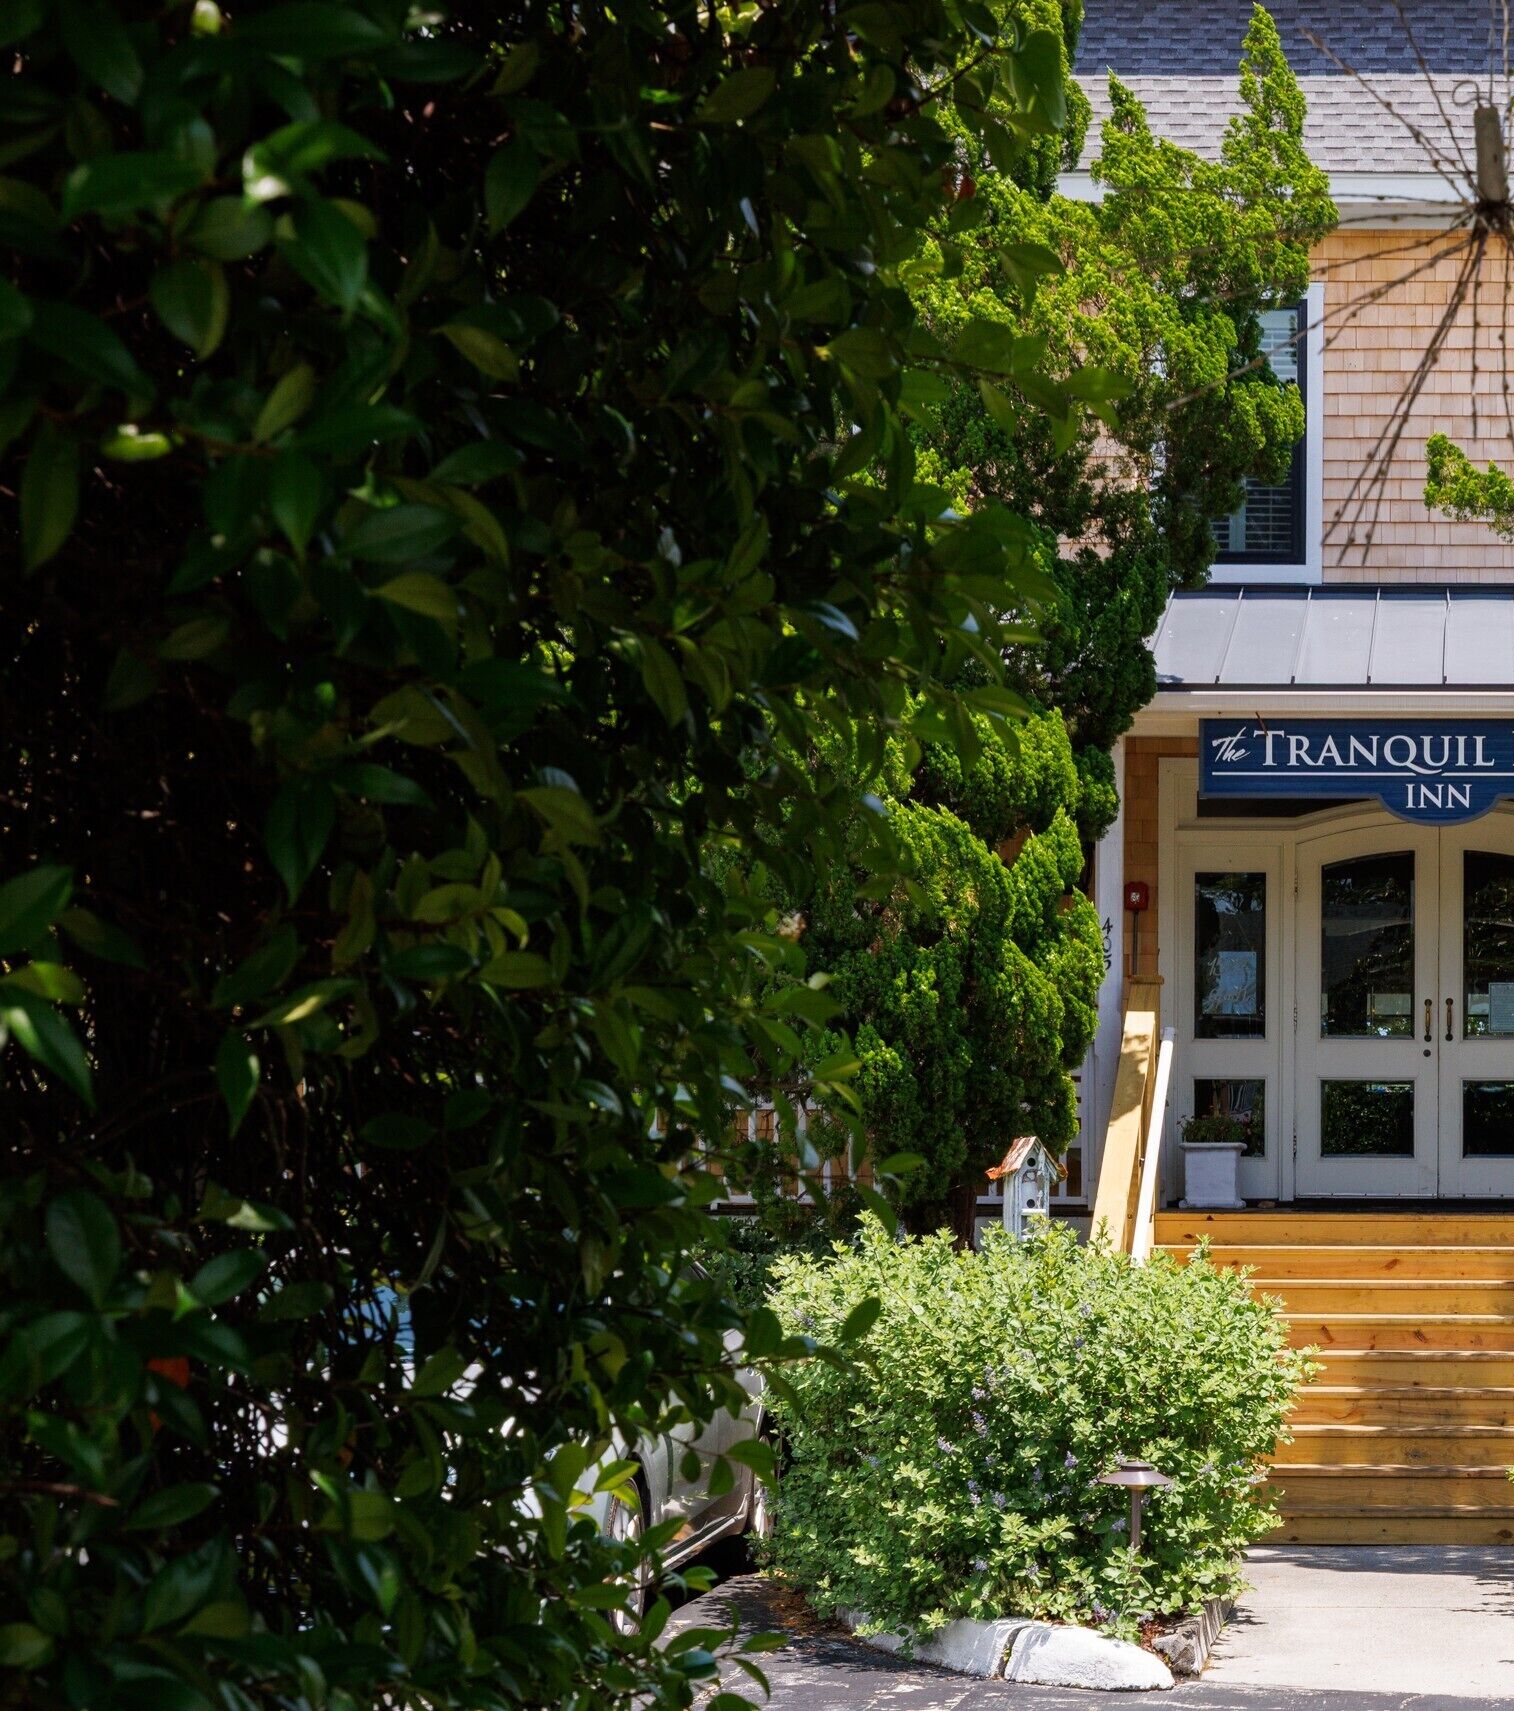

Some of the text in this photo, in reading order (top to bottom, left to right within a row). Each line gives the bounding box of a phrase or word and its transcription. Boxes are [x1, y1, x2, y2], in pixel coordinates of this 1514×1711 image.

[1211, 727, 1252, 762] The
[1253, 730, 1495, 775] TRANQUIL
[1405, 783, 1473, 809] INN
